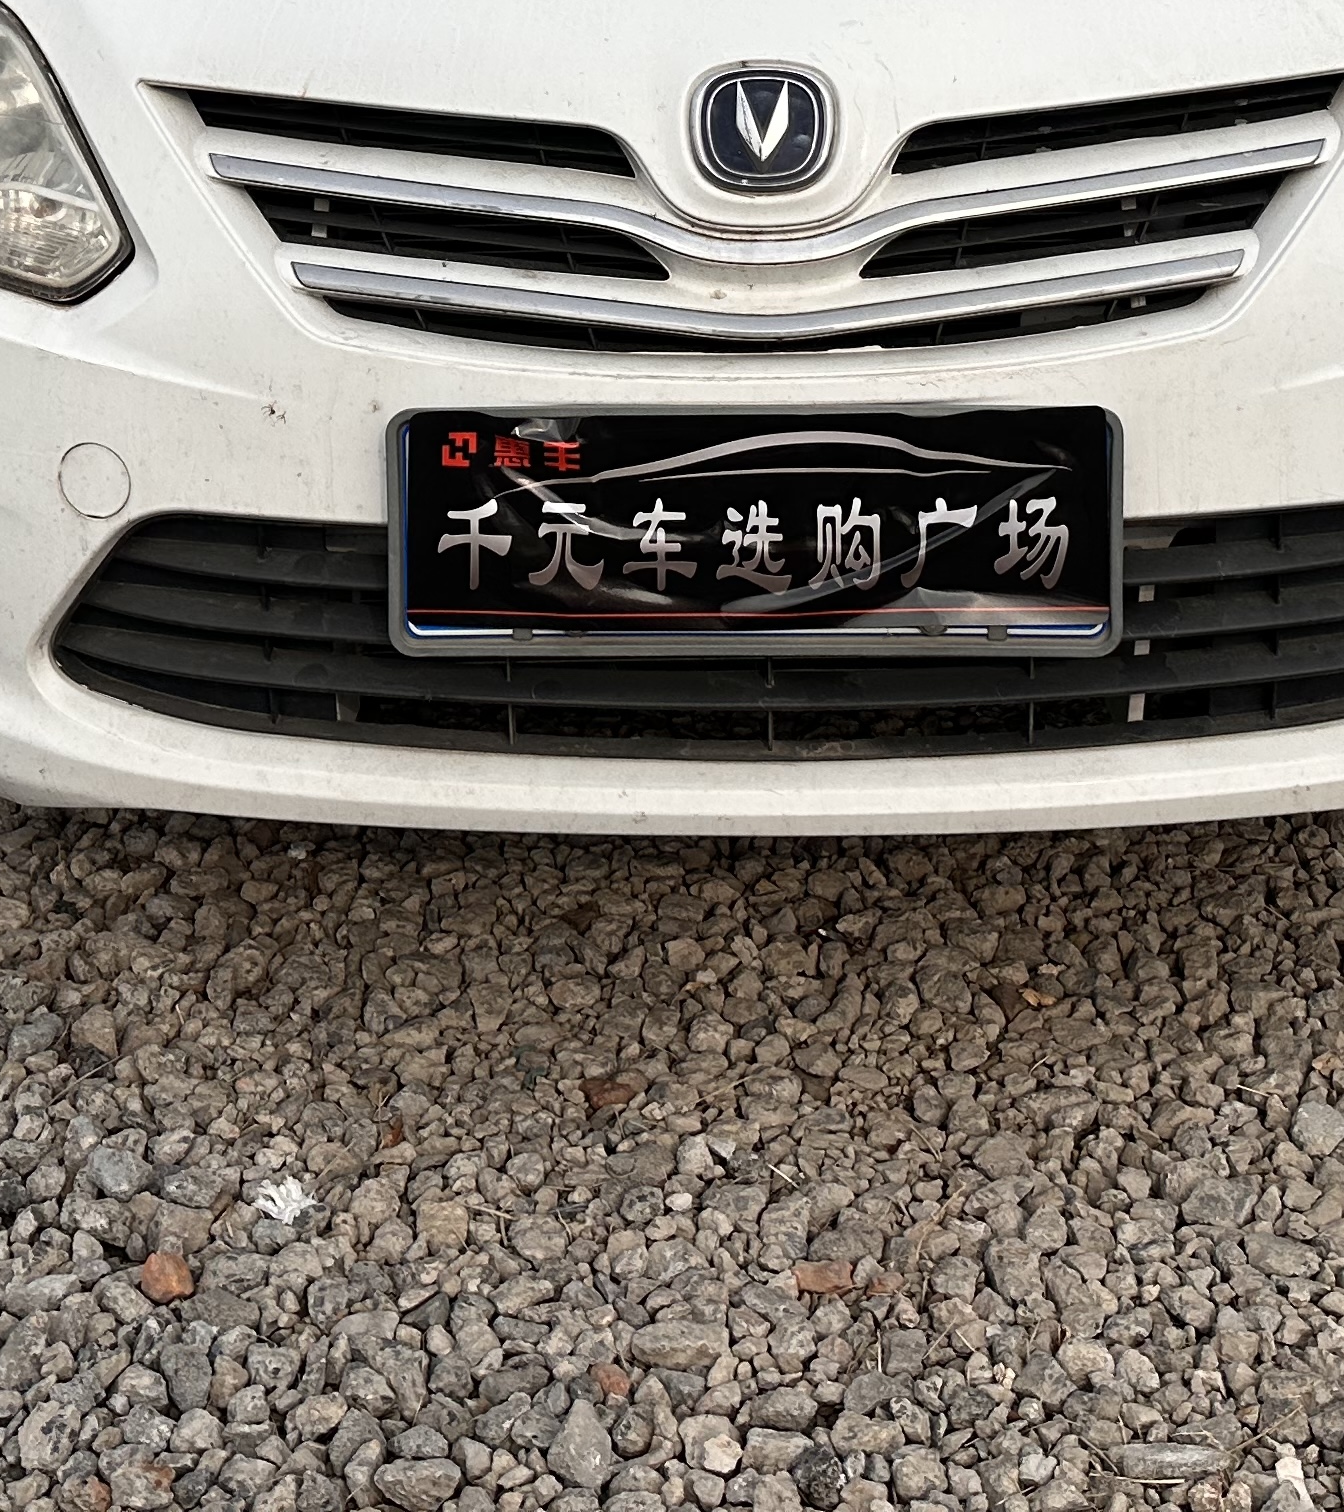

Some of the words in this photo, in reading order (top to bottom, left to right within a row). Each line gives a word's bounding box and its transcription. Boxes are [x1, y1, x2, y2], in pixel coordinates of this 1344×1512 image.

[438, 496, 1069, 595] 千元车选购广场
